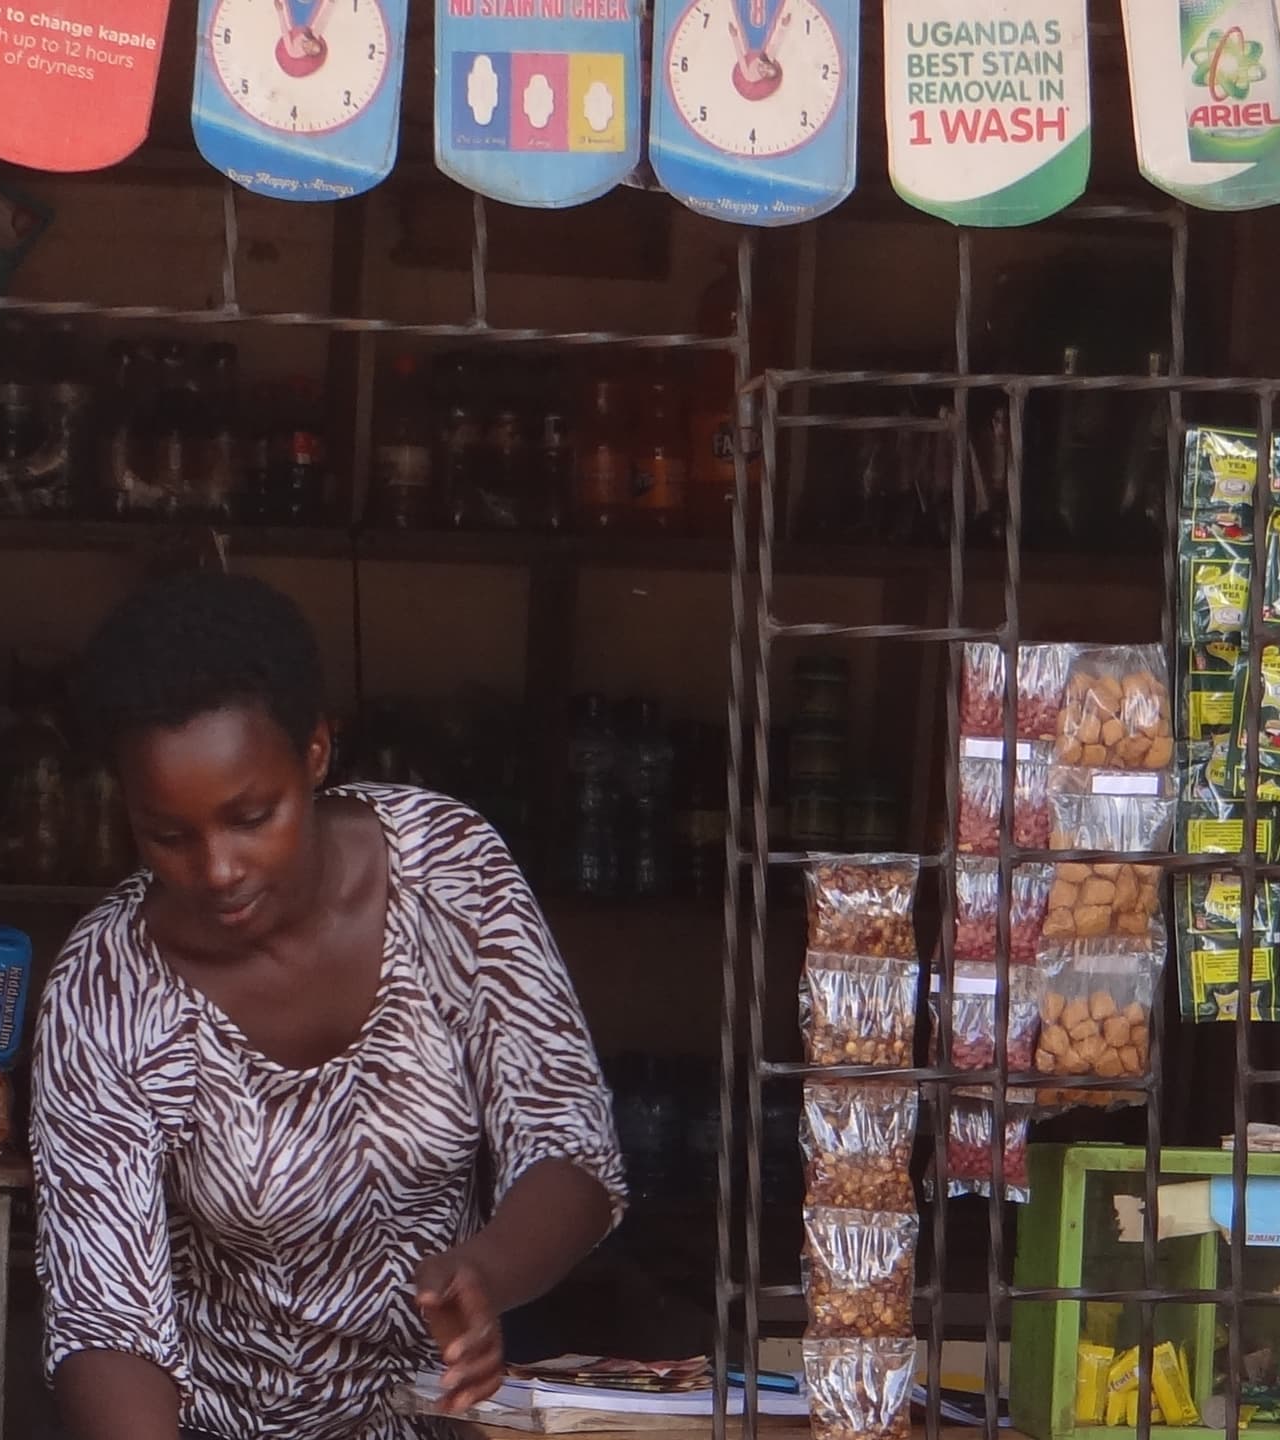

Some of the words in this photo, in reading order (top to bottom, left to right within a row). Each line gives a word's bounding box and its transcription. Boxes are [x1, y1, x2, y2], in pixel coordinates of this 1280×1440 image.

[6, 7, 25, 23] to
[29, 12, 94, 37] change
[98, 24, 157, 50] kapale
[223, 28, 232, 44] 6
[13, 34, 37, 51] up
[41, 37, 60, 53] to
[65, 40, 81, 58] 12
[85, 45, 135, 69] hours
[367, 43, 376, 61] 2
[4, 51, 23, 65] of
[27, 54, 95, 81] dryness
[680, 56, 689, 73] 6
[821, 64, 830, 81] 2
[907, 52, 975, 78] BEST
[982, 50, 1064, 77] STAIN
[241, 79, 249, 95] 5
[907, 80, 1032, 105] REMOVAL
[1038, 79, 1065, 101] IN
[343, 90, 352, 107] 3
[290, 104, 299, 122] 4
[699, 106, 708, 122] 5
[800, 110, 809, 127] 3
[909, 110, 932, 145] 1
[749, 128, 757, 145] 4
